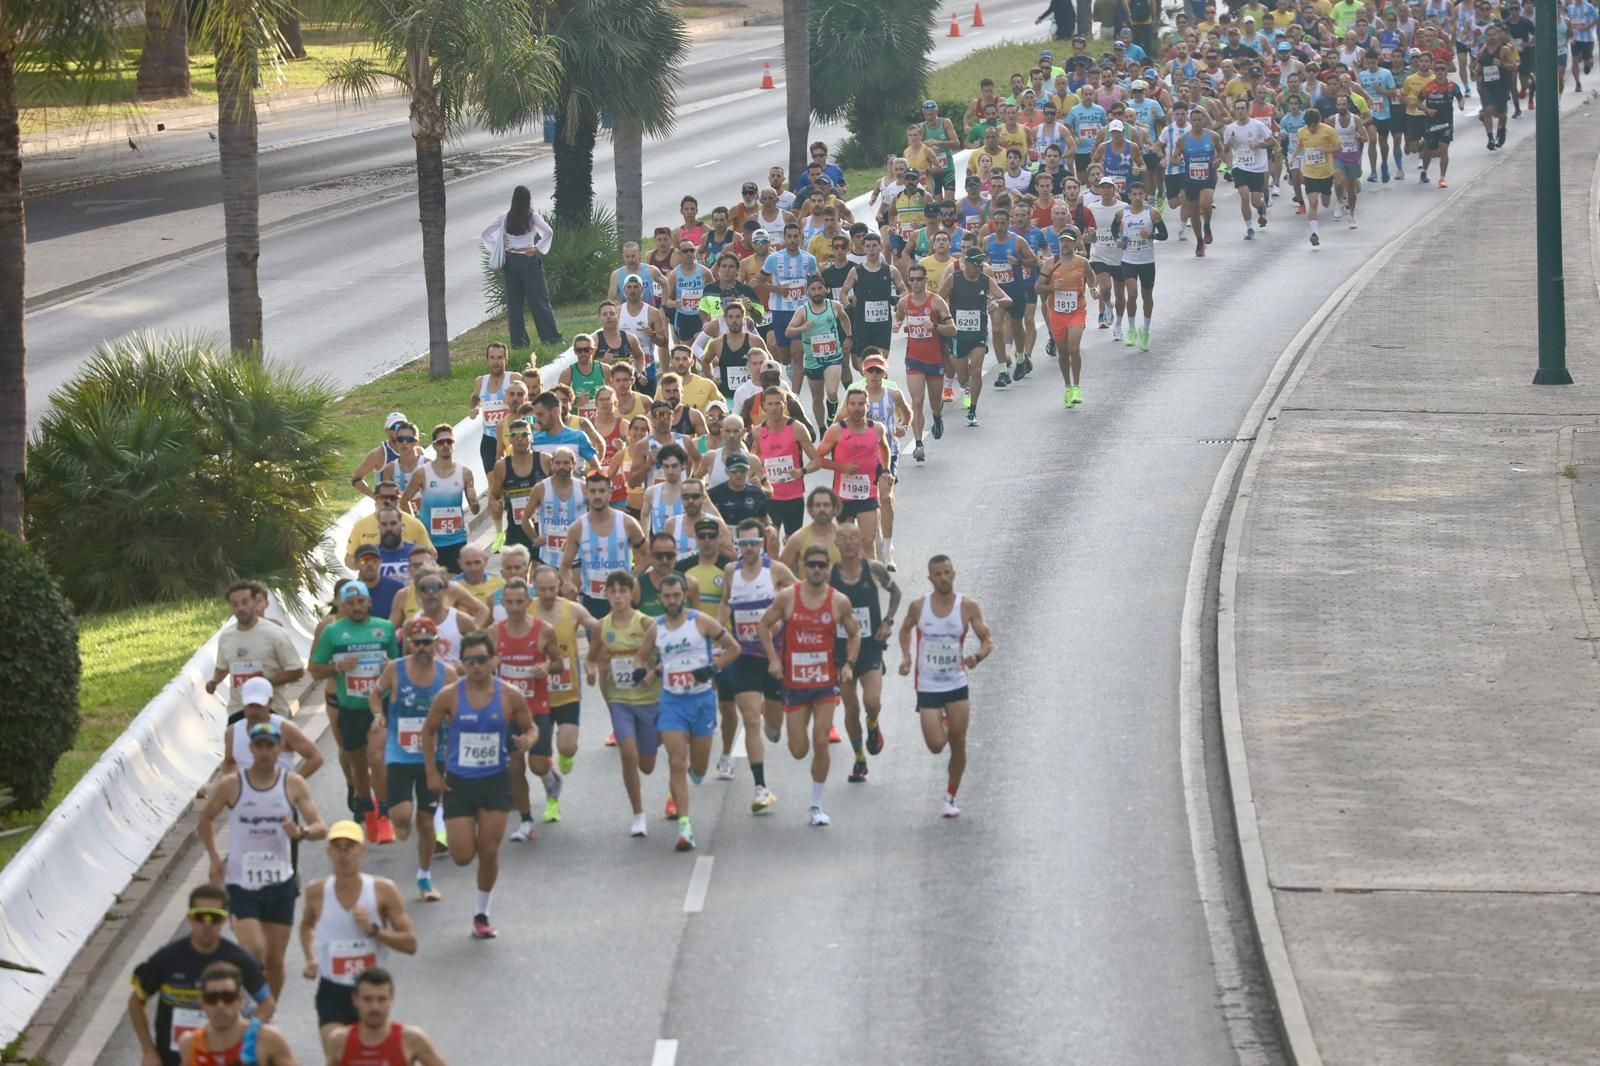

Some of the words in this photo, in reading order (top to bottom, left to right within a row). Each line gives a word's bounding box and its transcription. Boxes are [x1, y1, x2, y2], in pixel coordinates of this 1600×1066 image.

[678, 279, 701, 288] nerja
[1057, 301, 1076, 309] 1813
[487, 411, 504, 422] 227
[842, 484, 869, 493] 11949
[441, 520, 454, 530] 55
[926, 654, 957, 665] 11884
[464, 745, 497, 760] 7666
[247, 869, 281, 884] 1131
